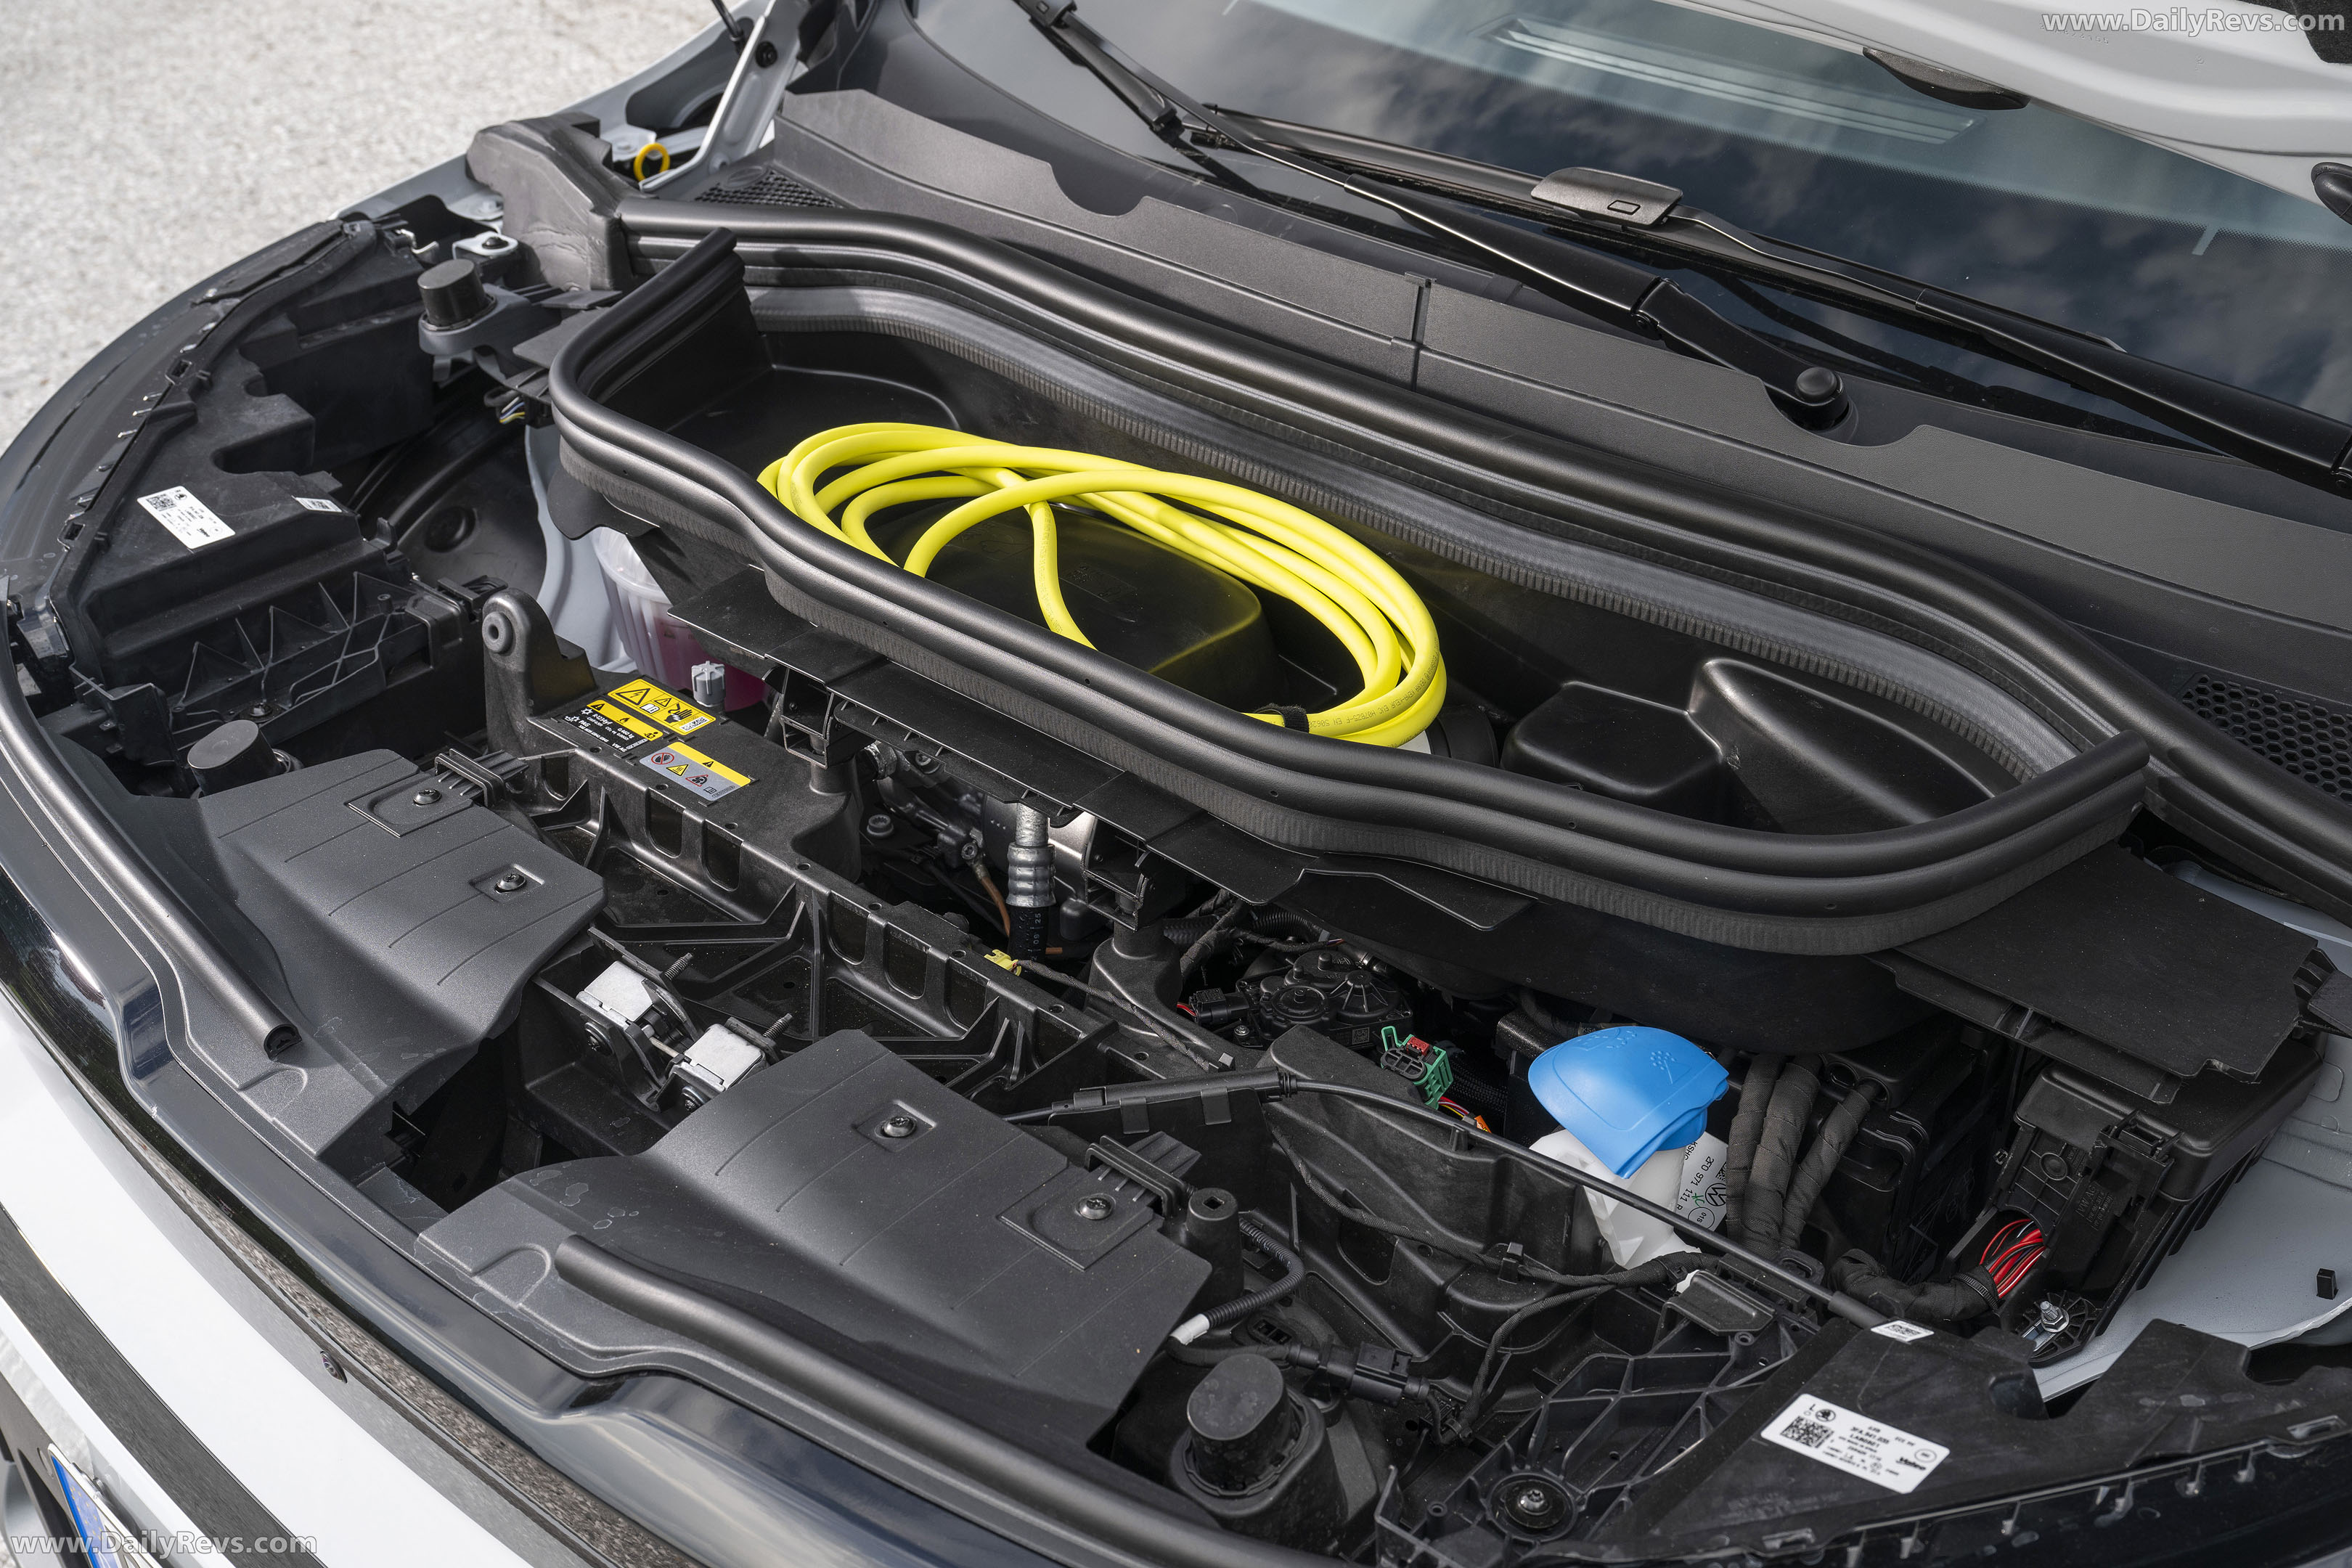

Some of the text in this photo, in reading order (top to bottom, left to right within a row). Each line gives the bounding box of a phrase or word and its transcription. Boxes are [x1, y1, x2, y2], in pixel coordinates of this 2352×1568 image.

[1701, 1156, 1715, 1172] 2F0
[1690, 1172, 1704, 1186] 971
[1680, 1188, 1693, 1202] 111
[1696, 1212, 1707, 1223] 01S
